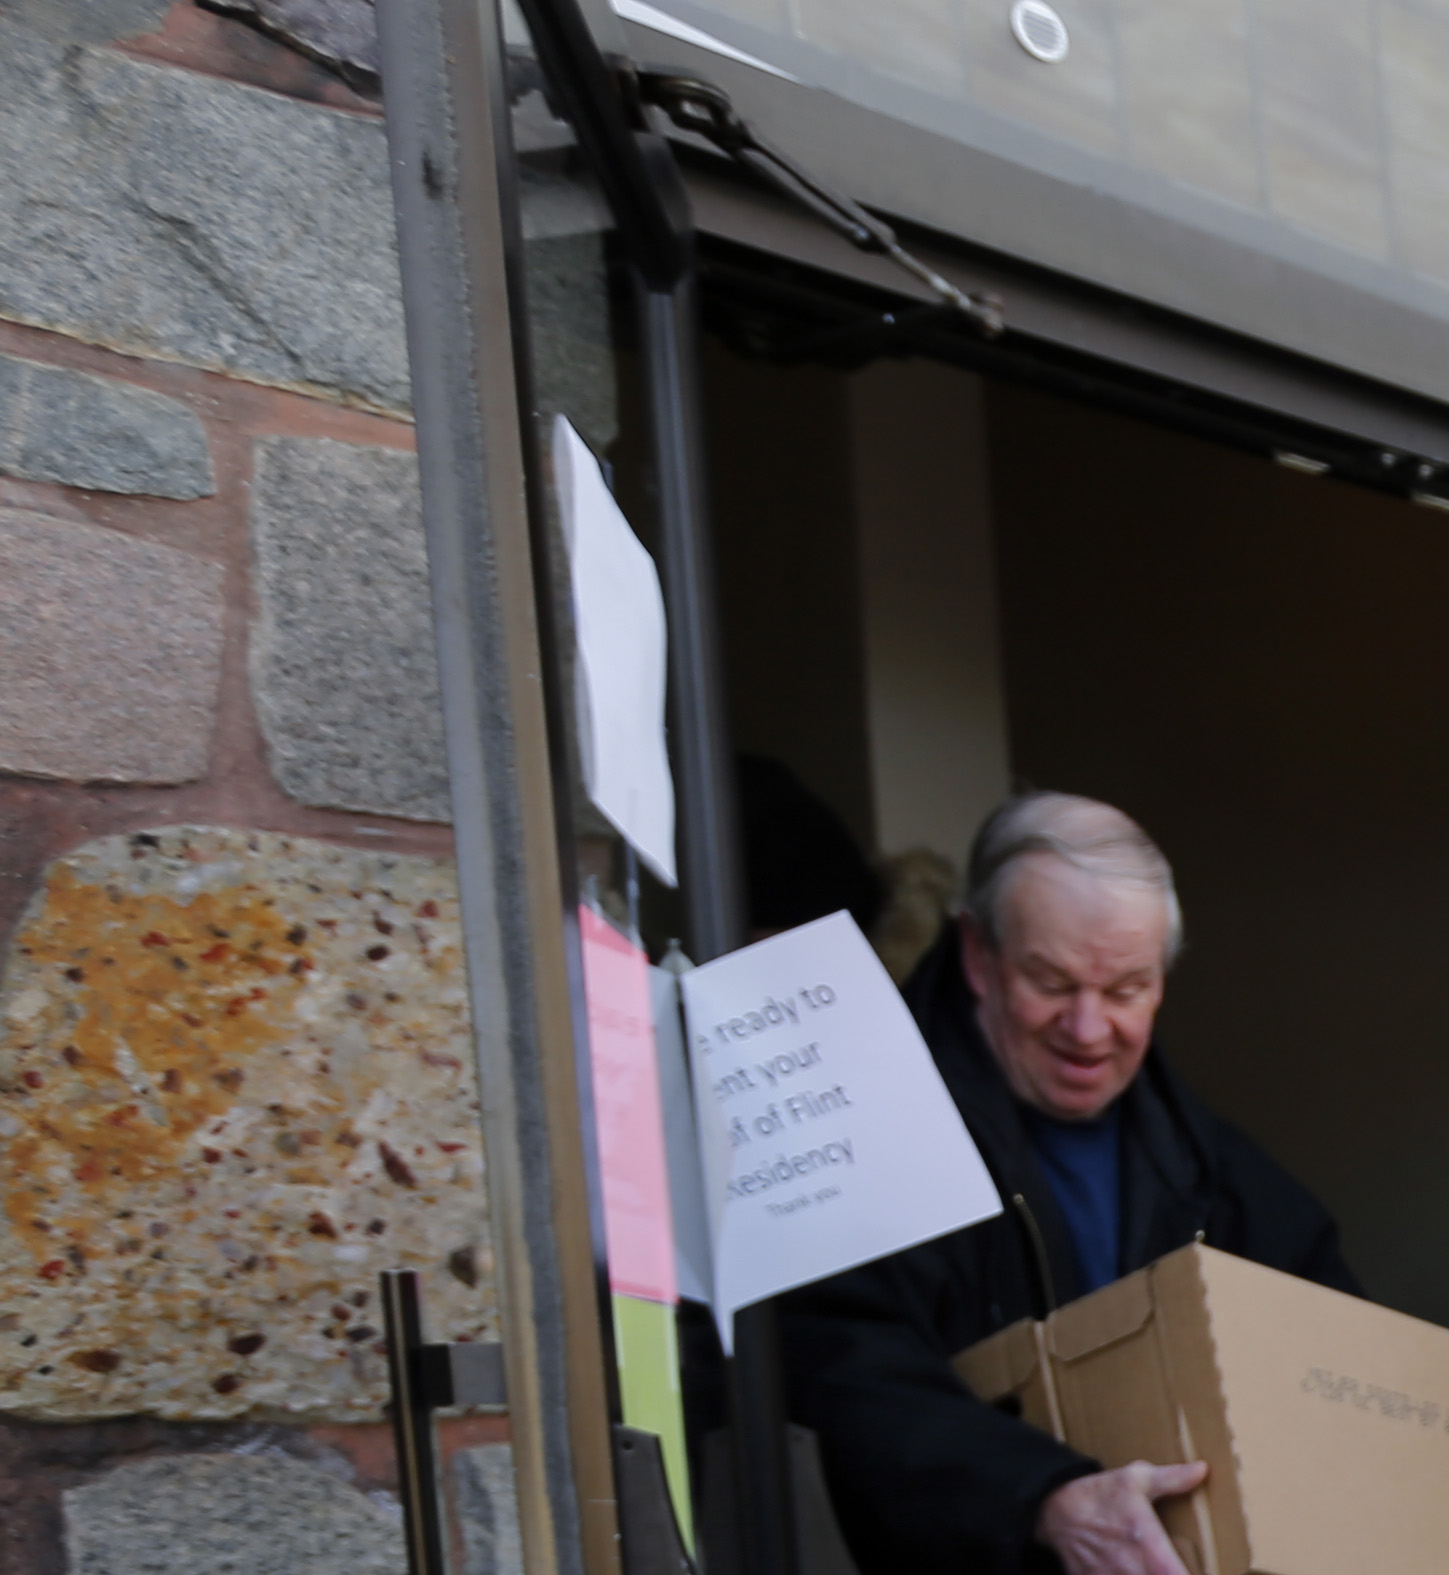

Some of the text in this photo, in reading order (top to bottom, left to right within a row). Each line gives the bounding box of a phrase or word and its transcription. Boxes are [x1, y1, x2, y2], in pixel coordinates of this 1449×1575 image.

[714, 995, 801, 1043] ready
[798, 984, 837, 1010] to
[754, 1042, 823, 1087] your
[753, 1102, 785, 1135] of
[785, 1083, 853, 1123] Flint
